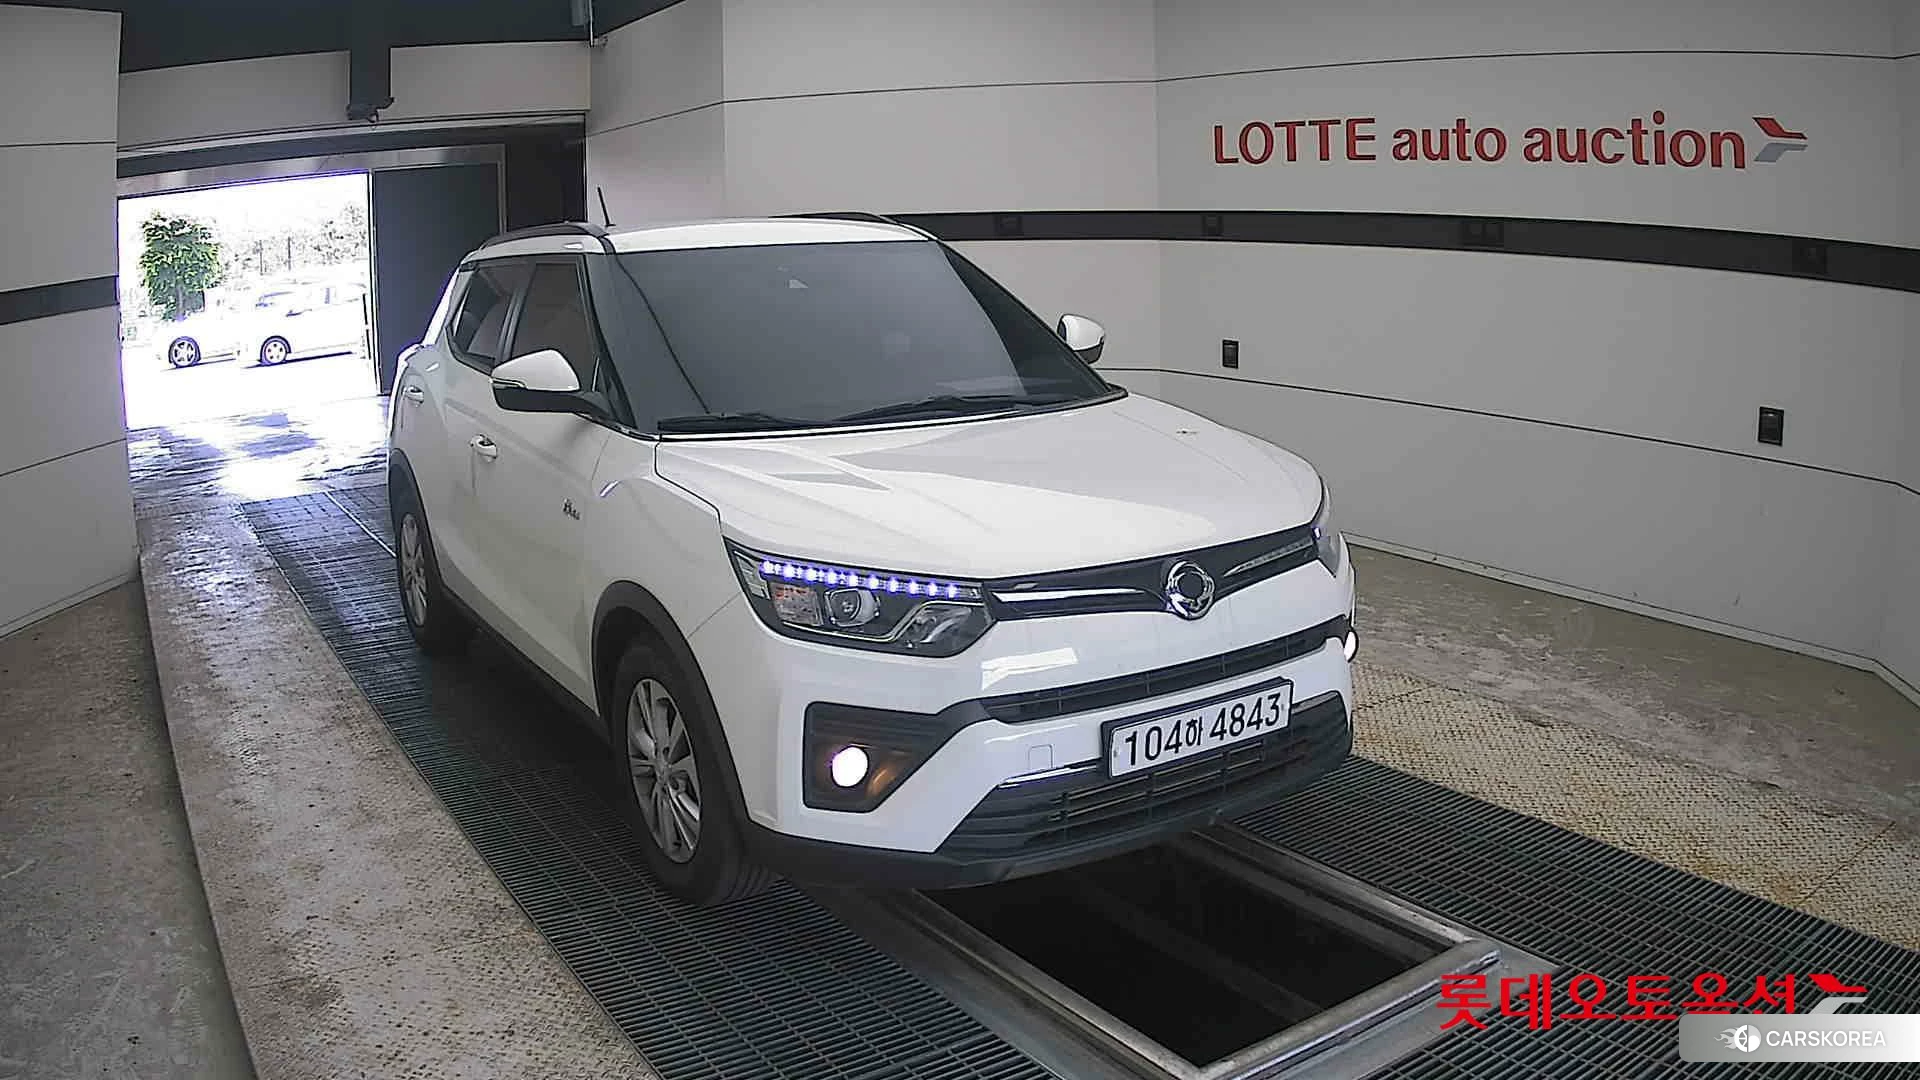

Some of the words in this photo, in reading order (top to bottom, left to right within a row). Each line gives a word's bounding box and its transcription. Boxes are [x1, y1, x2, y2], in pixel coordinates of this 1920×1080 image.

[1213, 117, 1377, 165] LOTTE
[1392, 118, 1508, 162] auto
[1523, 110, 1746, 169] auction
[1125, 715, 1203, 766] 104하
[1209, 692, 1281, 741] 4843
